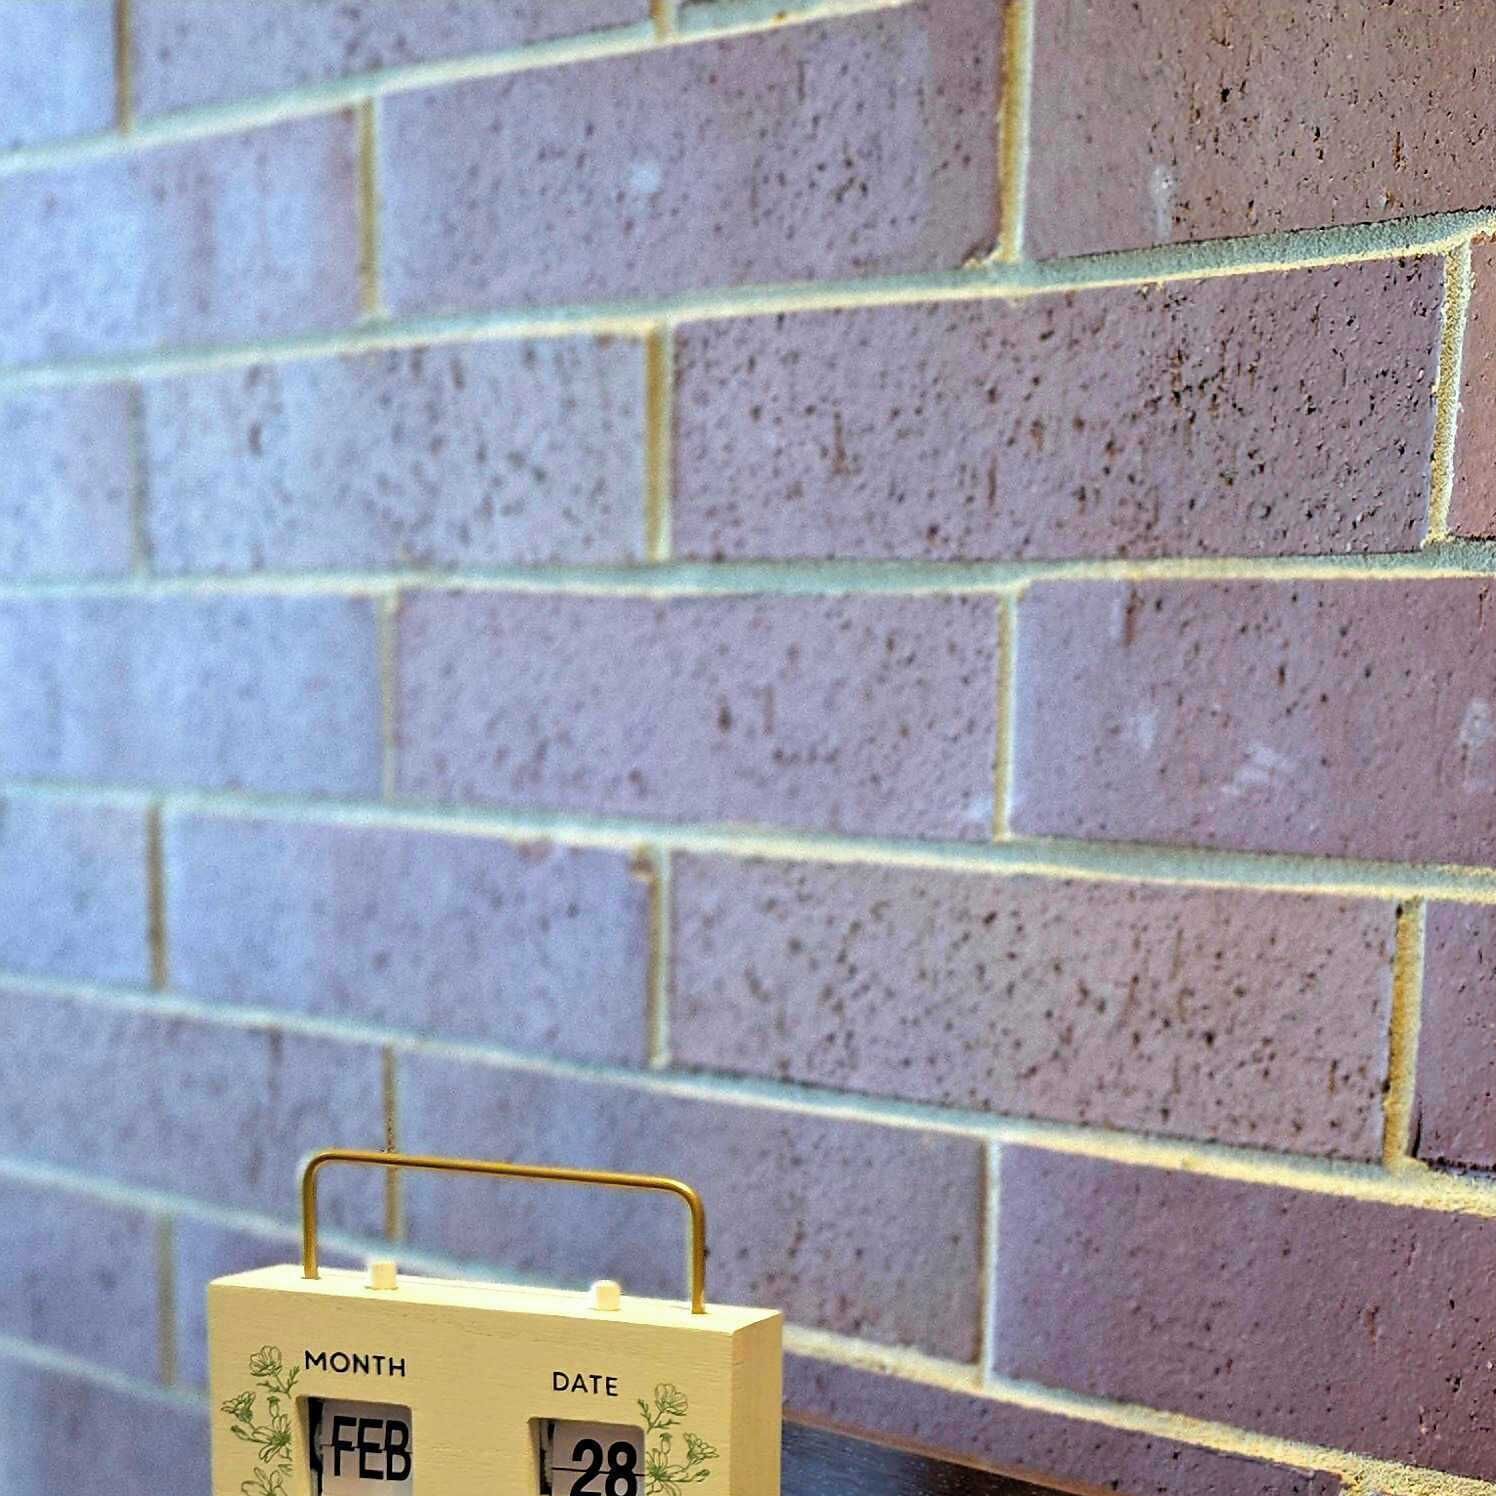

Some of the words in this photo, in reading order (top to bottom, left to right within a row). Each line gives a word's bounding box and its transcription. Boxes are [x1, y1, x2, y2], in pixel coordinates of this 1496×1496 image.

[304, 1350, 406, 1377] MONTH
[552, 1371, 618, 1397] DATE
[333, 1416, 412, 1481] FEB
